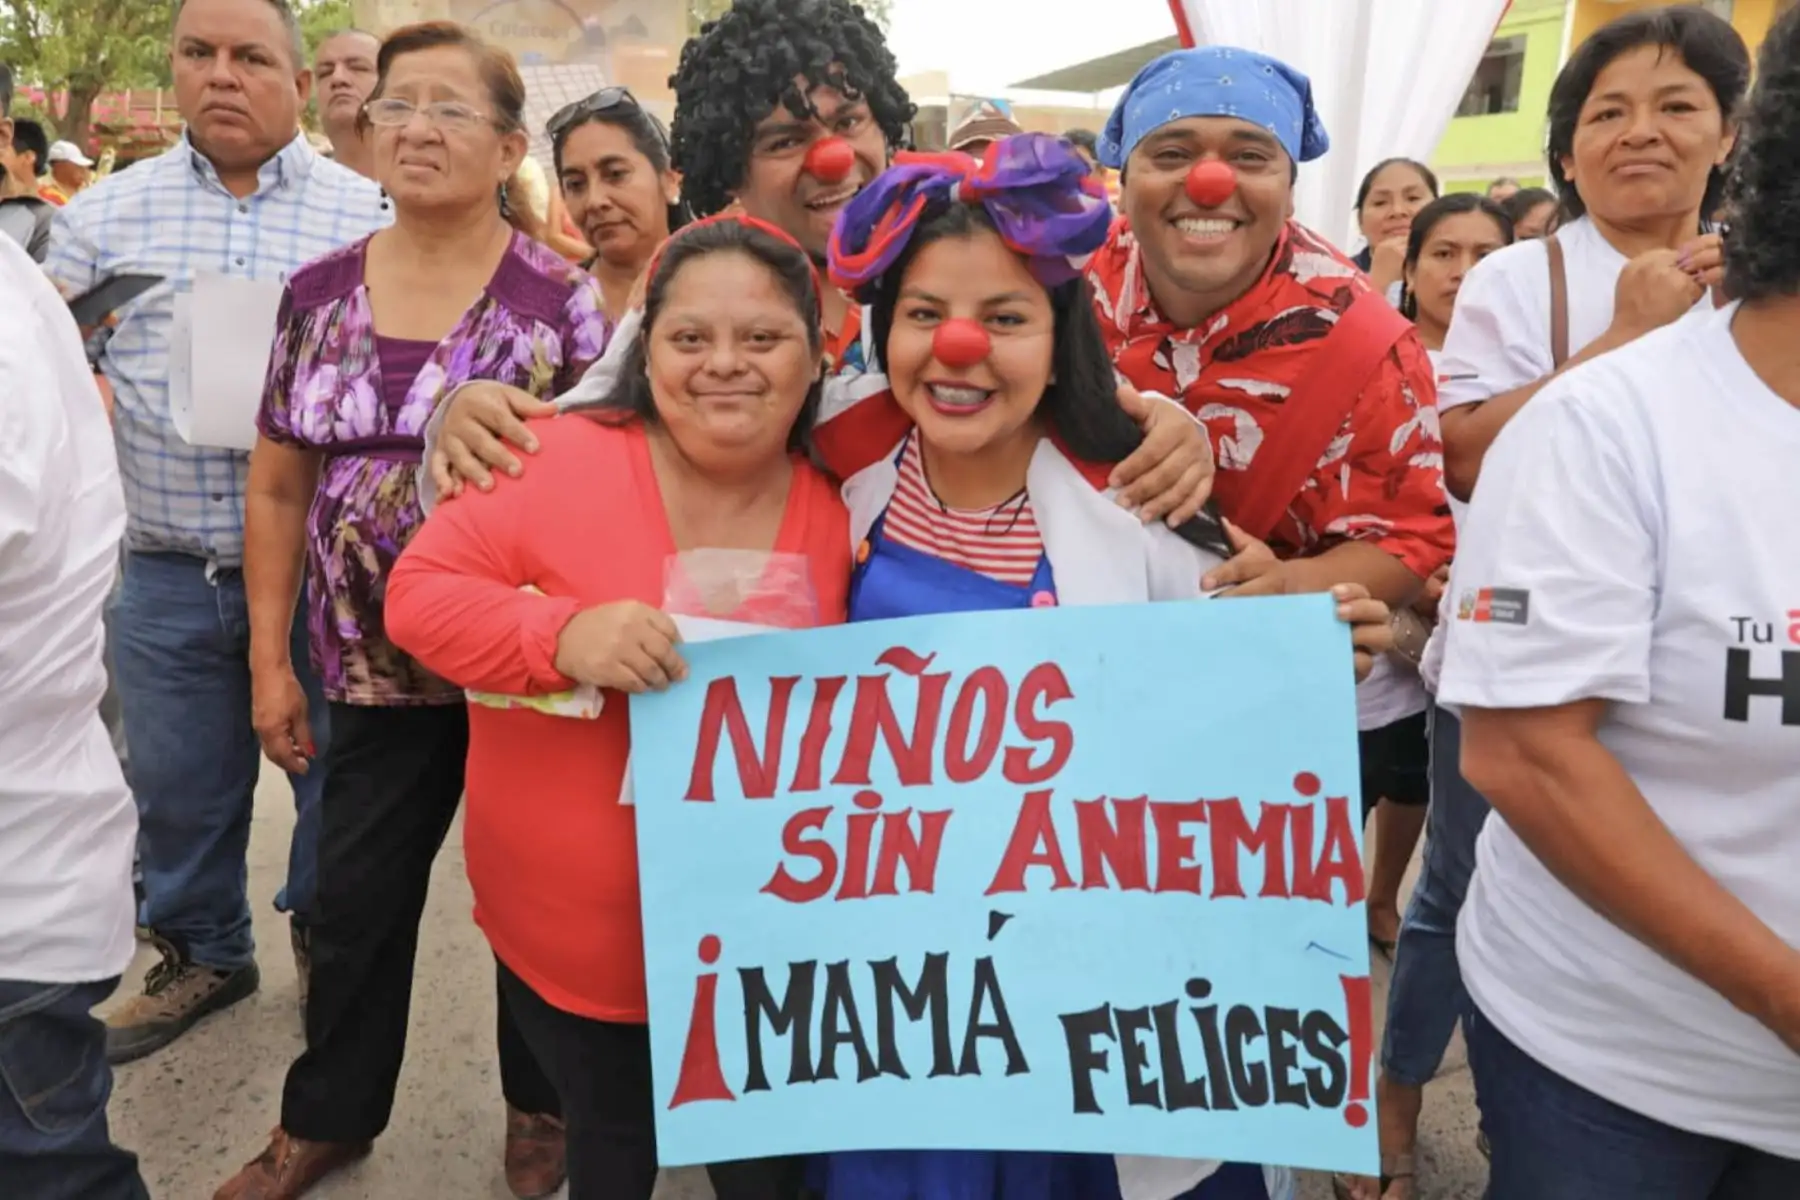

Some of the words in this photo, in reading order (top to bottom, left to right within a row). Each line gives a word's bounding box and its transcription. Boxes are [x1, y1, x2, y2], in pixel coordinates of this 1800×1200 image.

[1729, 616, 1773, 644] Tu
[684, 645, 1075, 803] NIÑOS
[667, 910, 1031, 1111] ¡MAMÁ
